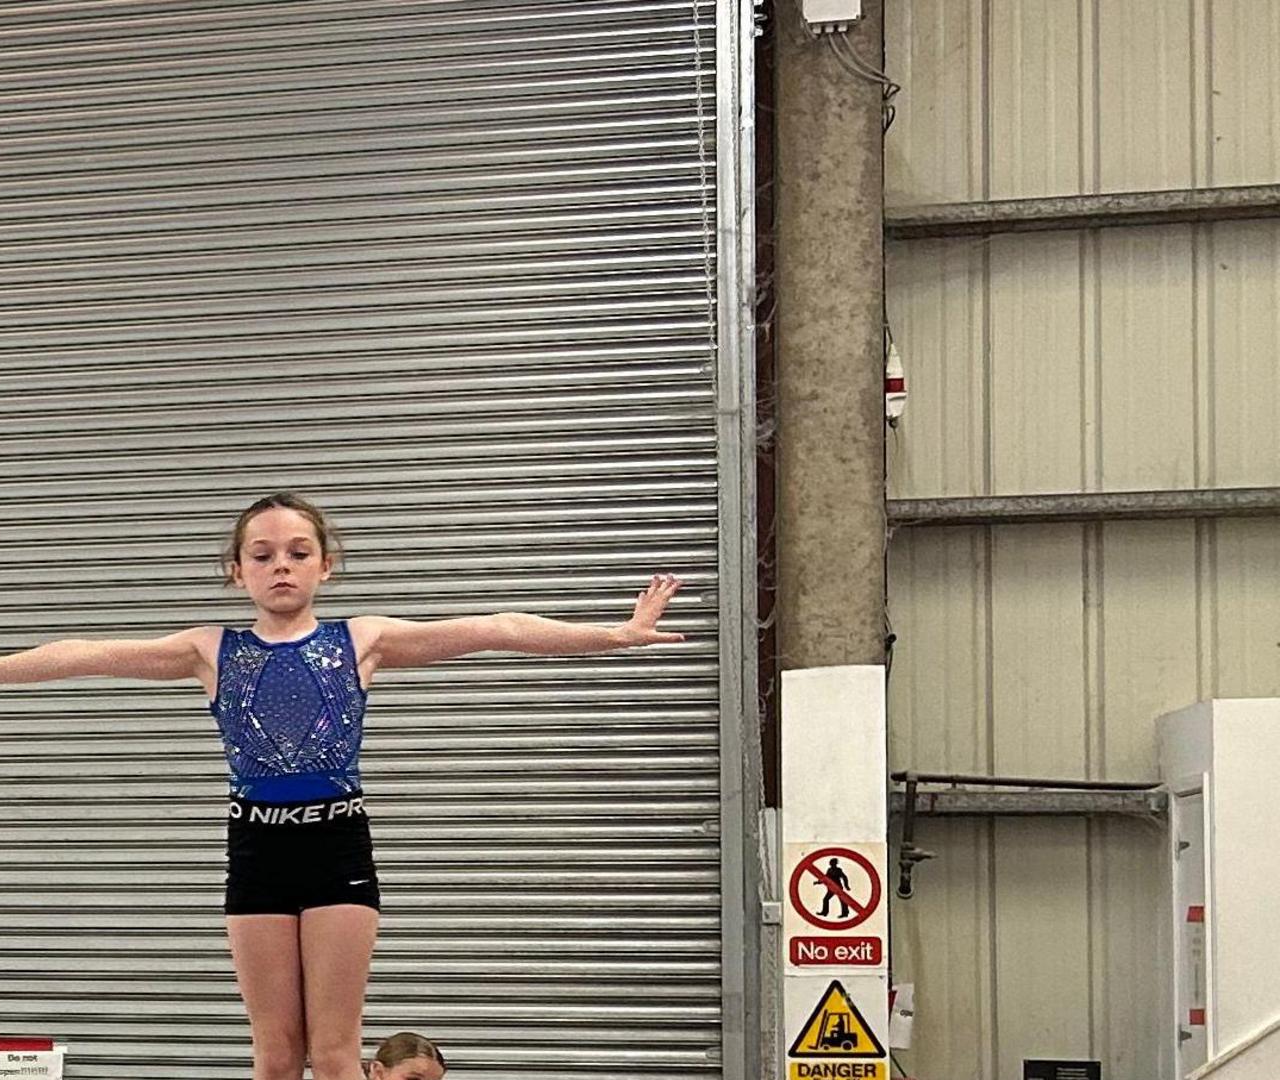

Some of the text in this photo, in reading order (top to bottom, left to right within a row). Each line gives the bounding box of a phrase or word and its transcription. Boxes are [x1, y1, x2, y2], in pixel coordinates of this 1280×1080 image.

[248, 803, 326, 825] NIKE
[327, 797, 364, 821] PR
[797, 941, 874, 961] No exit
[797, 1063, 877, 1078] DANGER
